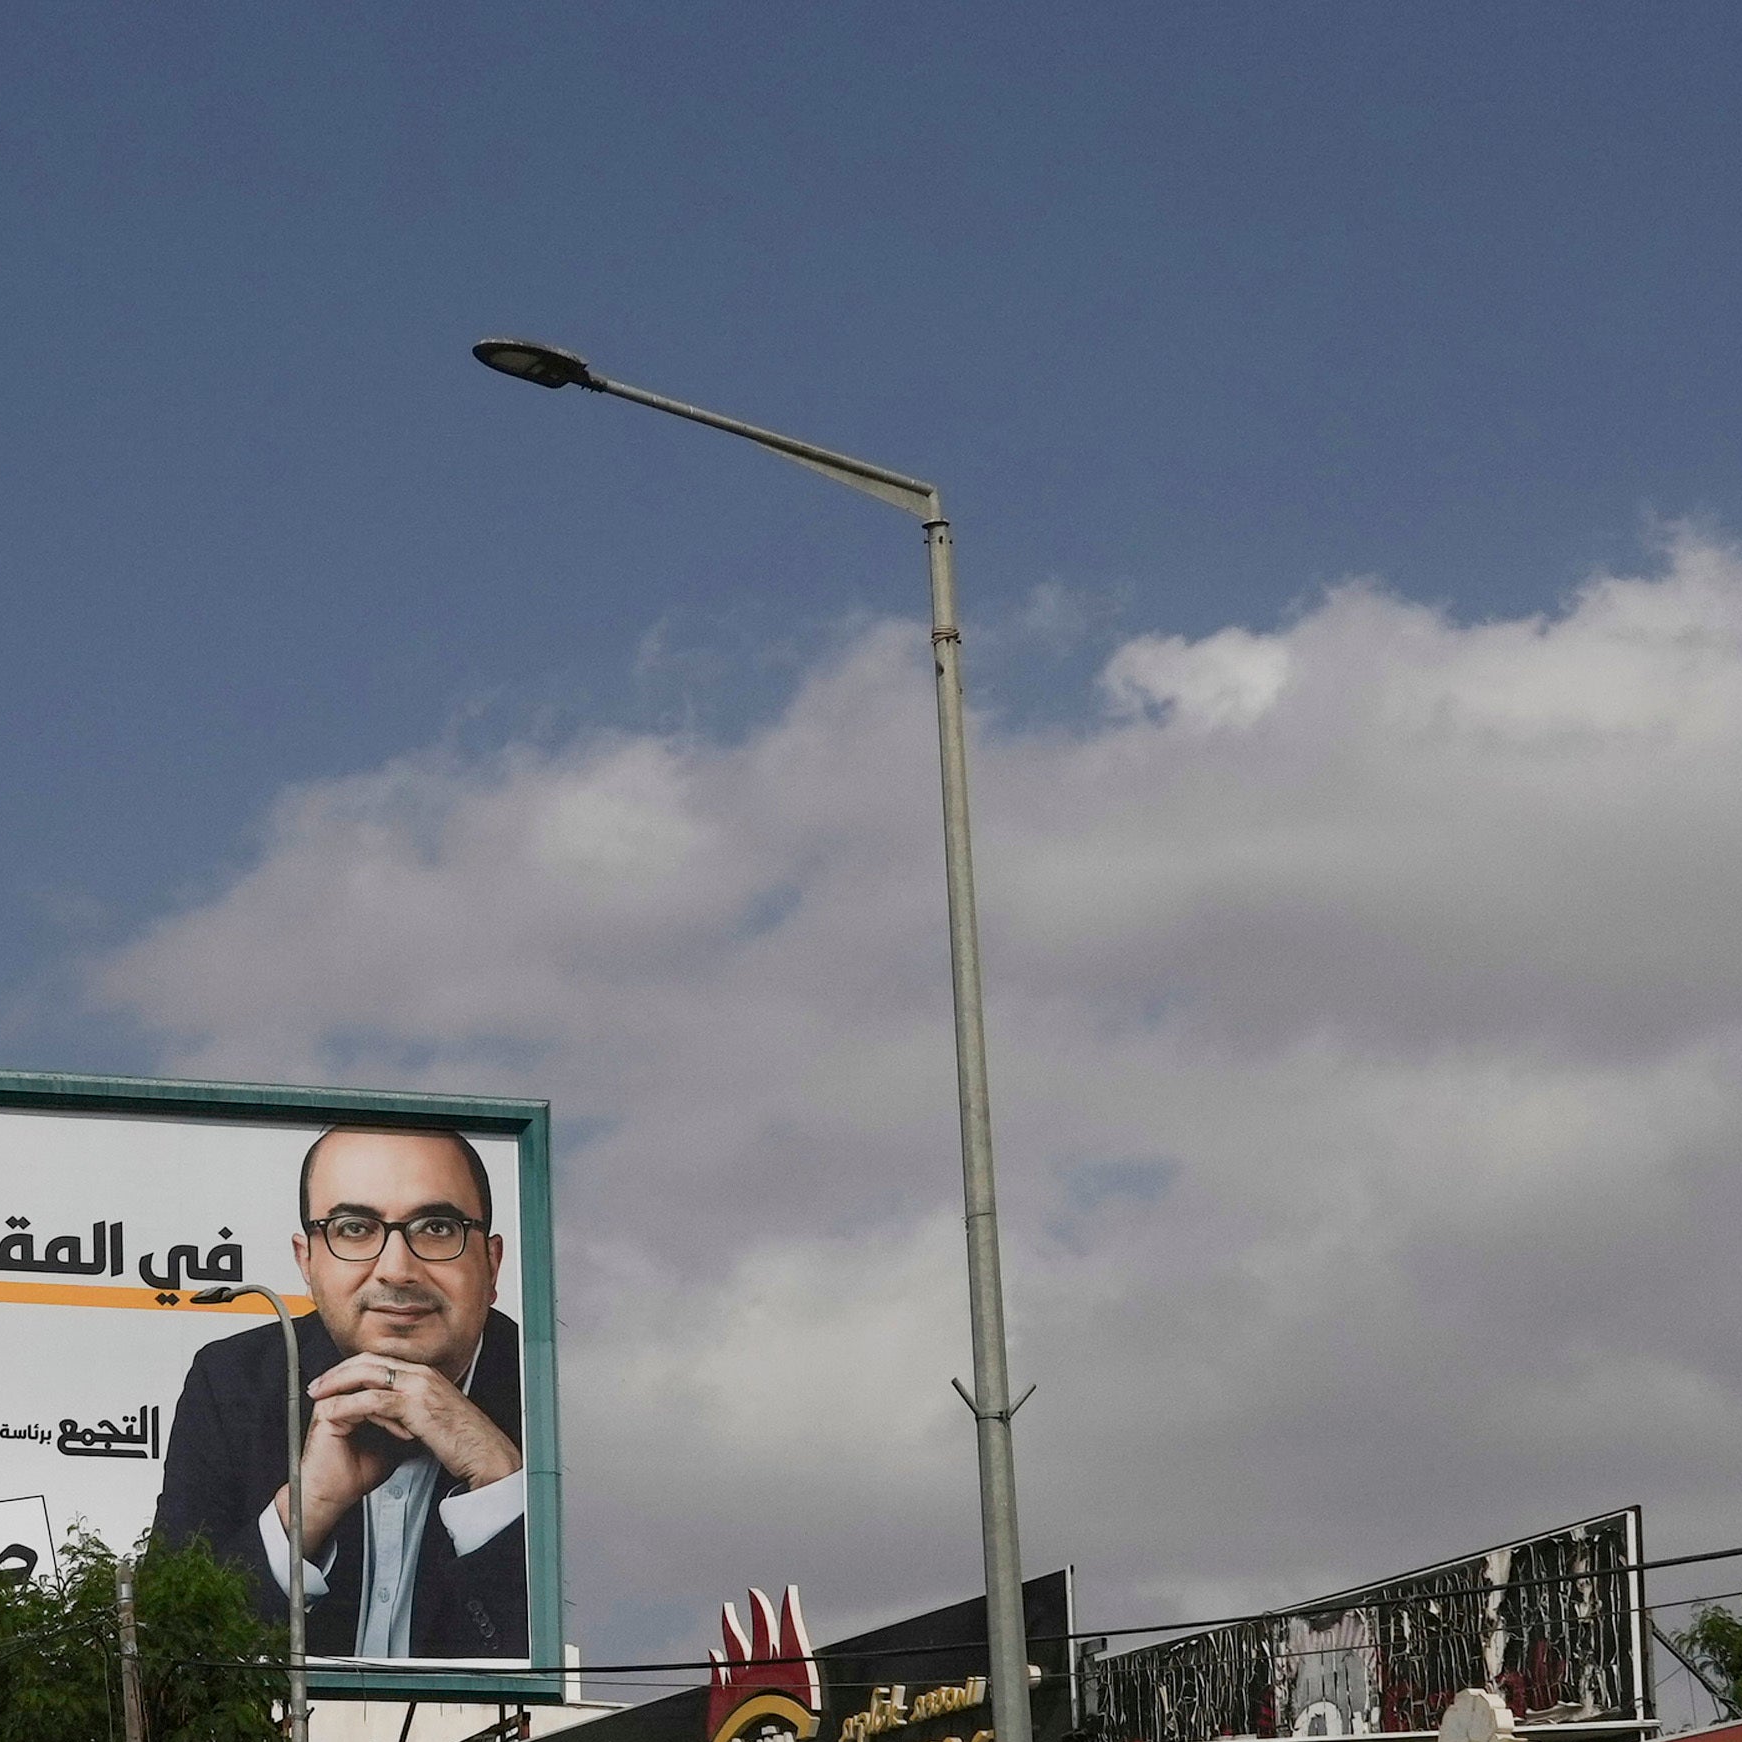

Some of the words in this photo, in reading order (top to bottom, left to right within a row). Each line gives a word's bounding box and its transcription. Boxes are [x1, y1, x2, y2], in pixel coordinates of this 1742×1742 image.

[139, 1226, 243, 1306] في
[0, 1420, 52, 1444] برئاسة
[57, 1405, 159, 1459] التجمع
